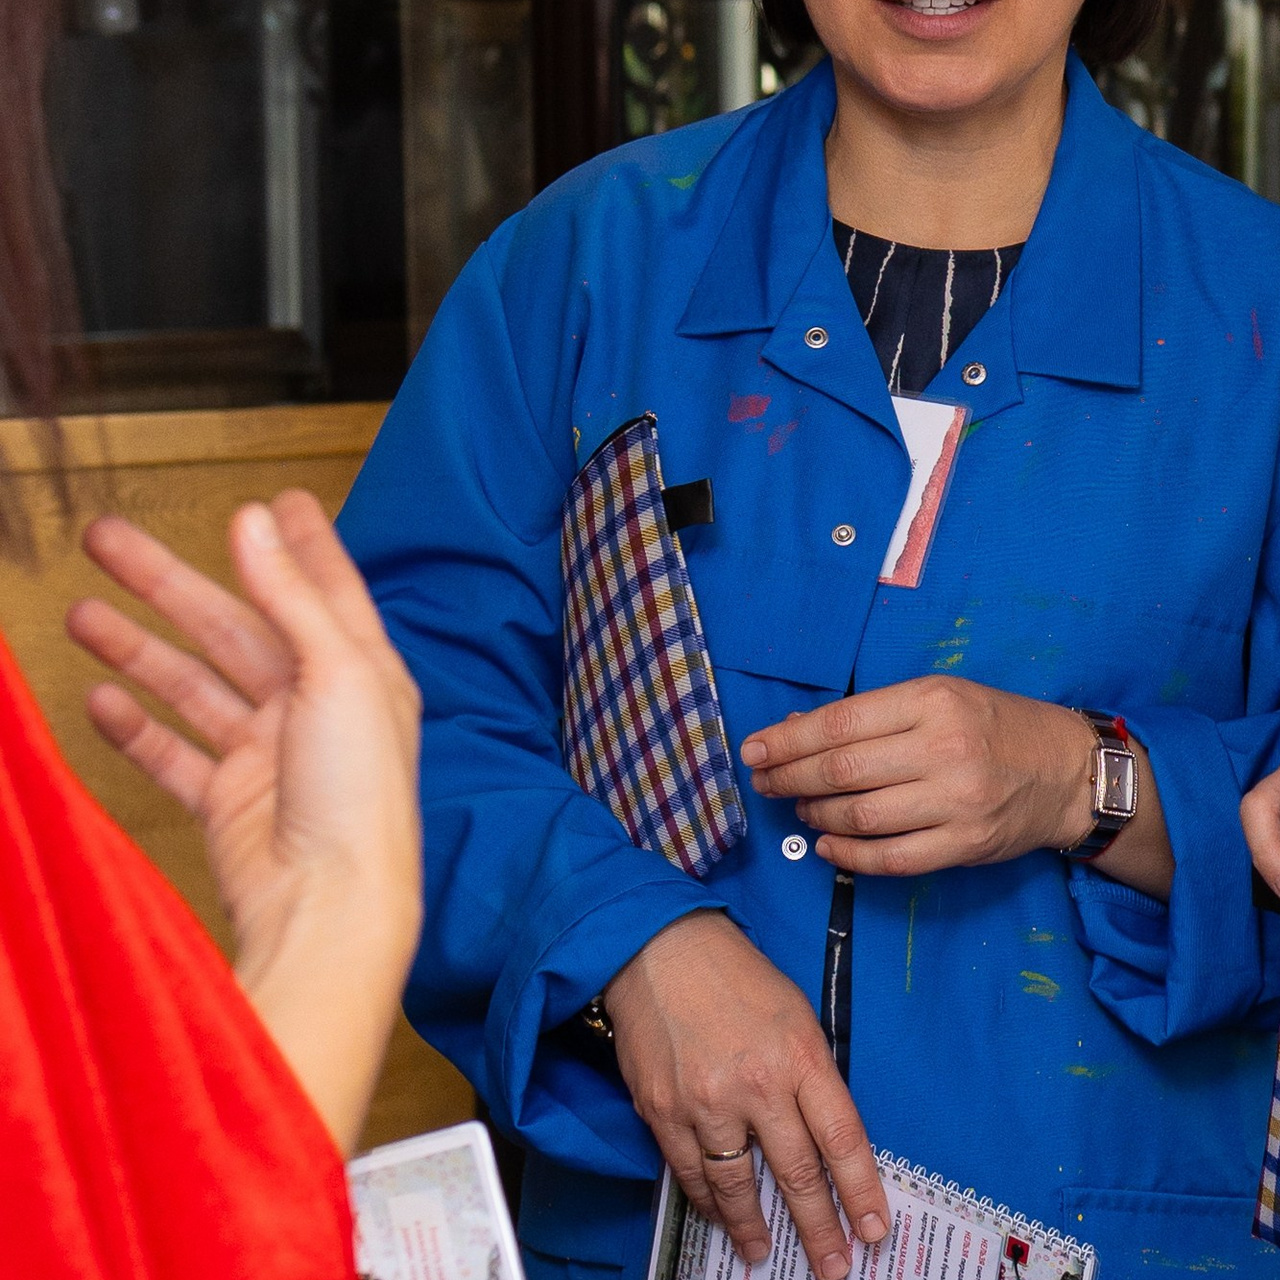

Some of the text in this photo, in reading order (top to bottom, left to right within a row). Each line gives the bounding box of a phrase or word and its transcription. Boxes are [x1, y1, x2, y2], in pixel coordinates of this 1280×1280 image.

[774, 1214, 785, 1245] рубашке
[902, 1212, 913, 1233] ЕСЛИ
[929, 1214, 939, 1232] Если
[897, 1230, 910, 1268] ПОКАЗАЛИ
[913, 1210, 928, 1277] карточку СЮРПРИЗ!
[943, 1222, 956, 1257] Предметы
[788, 1257, 797, 1278] отказ
[858, 1250, 869, 1277] своему
[887, 1252, 895, 1274] затем
